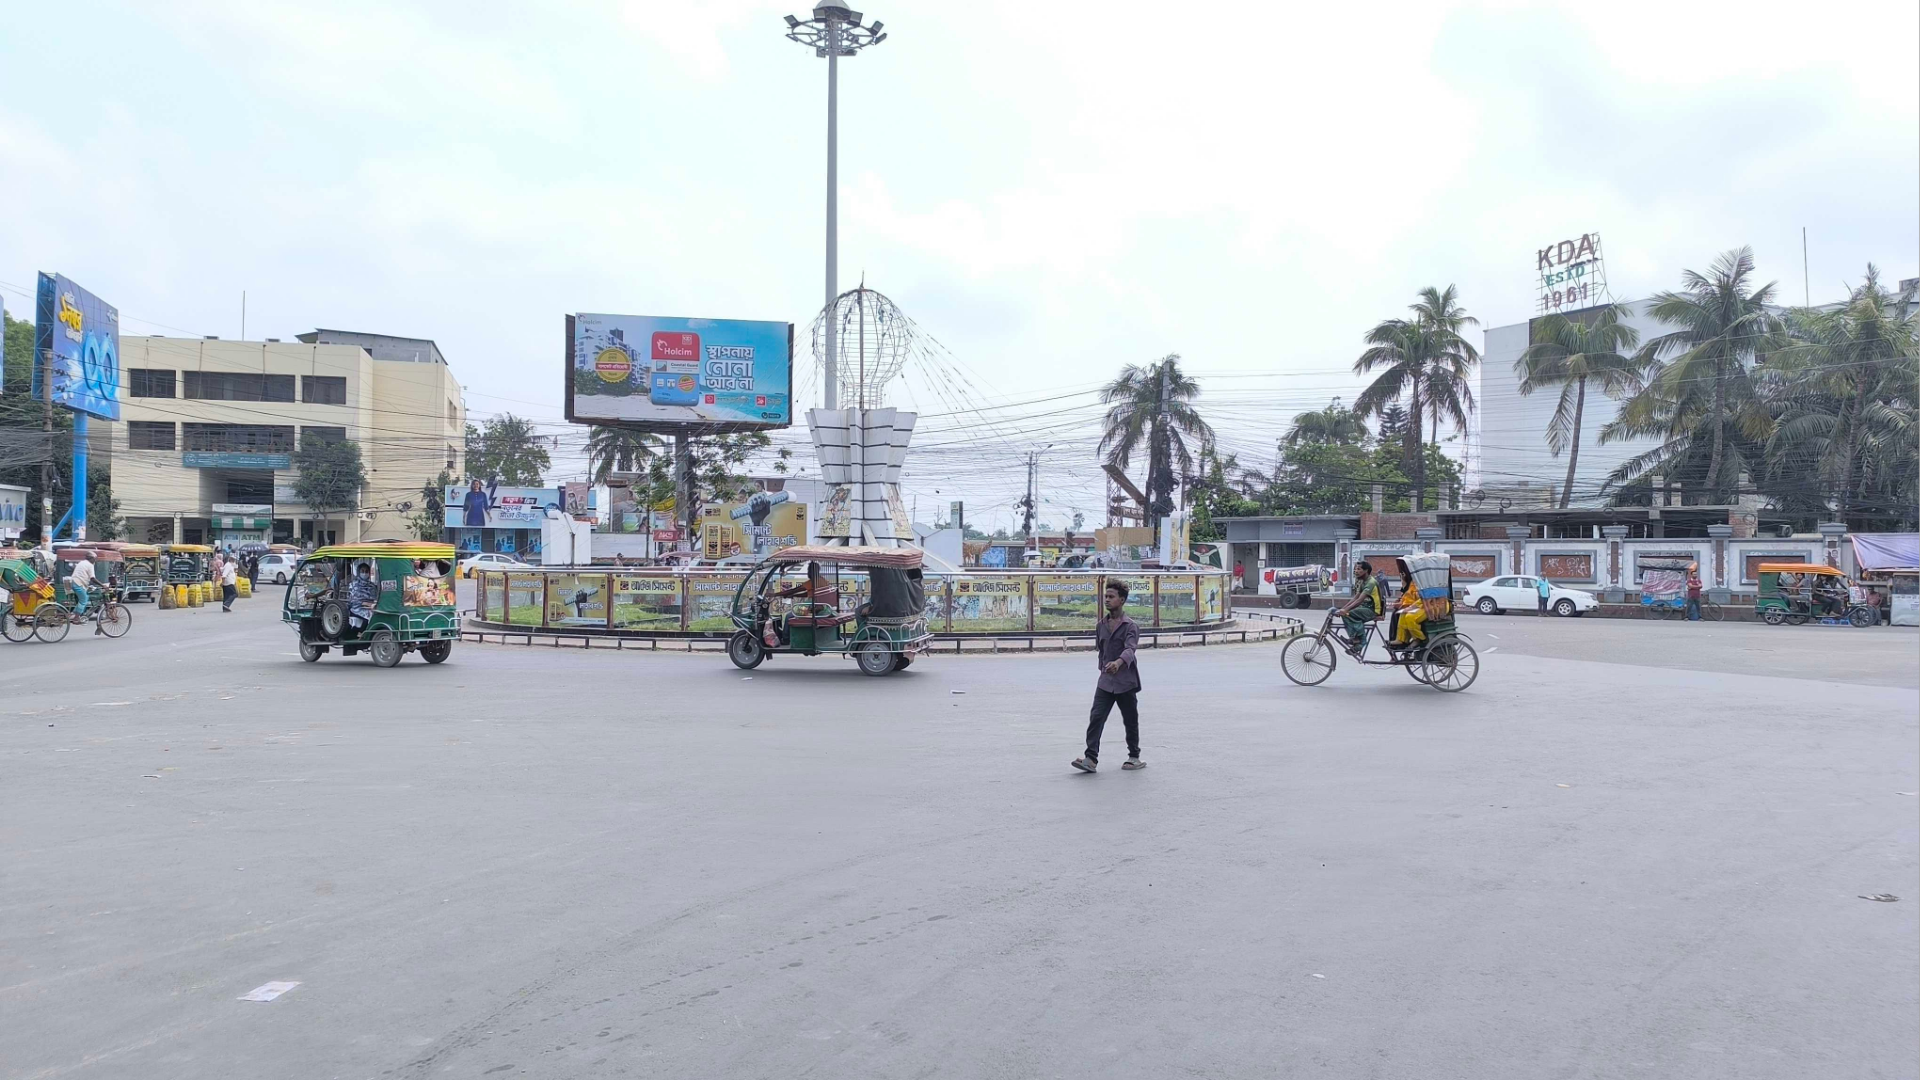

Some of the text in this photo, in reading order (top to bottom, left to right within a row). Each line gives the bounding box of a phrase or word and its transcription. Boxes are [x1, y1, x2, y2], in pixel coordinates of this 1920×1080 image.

[1538, 233, 1595, 270] KDA
[1546, 265, 1585, 286] ESTD
[1542, 282, 1588, 310] 1961
[664, 347, 692, 356] Holcim
[705, 345, 755, 360] স্থাপনায়
[705, 360, 755, 377] নোনা
[705, 376, 754, 391] আর না
[652, 581, 675, 591] সিমেন্ট
[722, 582, 741, 591] লোহা
[973, 581, 1020, 592] আকিজ সিমেন্ট
